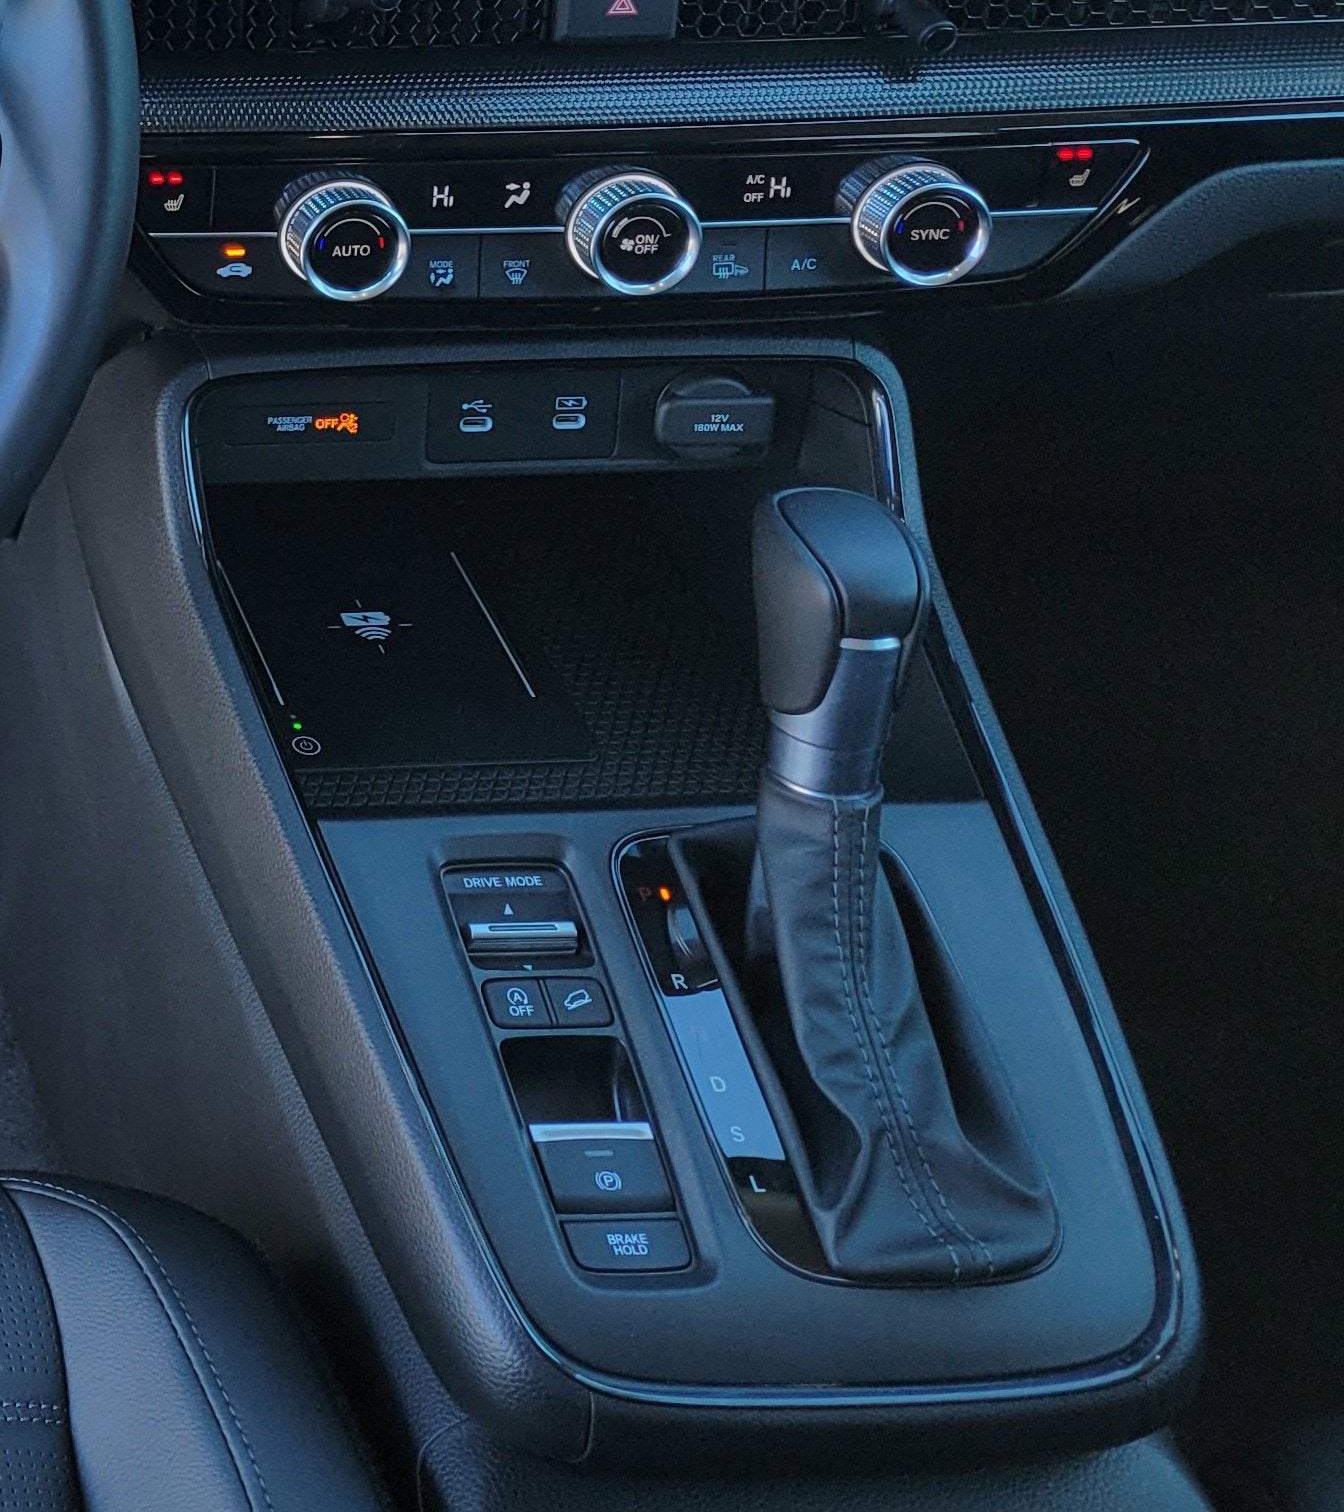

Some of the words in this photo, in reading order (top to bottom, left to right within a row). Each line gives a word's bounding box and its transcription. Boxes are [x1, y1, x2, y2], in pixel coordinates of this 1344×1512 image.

[746, 174, 766, 185] A/C
[743, 192, 764, 203] OFF
[910, 227, 951, 242] SYNC
[332, 243, 371, 258] AUTO
[634, 244, 659, 254] OFF
[429, 260, 454, 269] MODE
[712, 254, 735, 263] REAR
[790, 256, 818, 272] A/C
[503, 260, 531, 270] FRONT
[267, 416, 313, 425] PASSENGER
[711, 414, 730, 422] 12V
[276, 424, 305, 432] AIRBAG
[720, 424, 744, 432] MAX
[463, 876, 502, 889] DRIVE
[505, 875, 543, 888] MODE
[671, 973, 689, 990] R
[509, 1005, 535, 1017] OFF
[709, 1076, 727, 1093] D
[730, 1125, 746, 1143] S
[749, 1175, 767, 1194] L
[607, 1233, 649, 1246] BRAKE
[613, 1244, 649, 1257] HOLD
